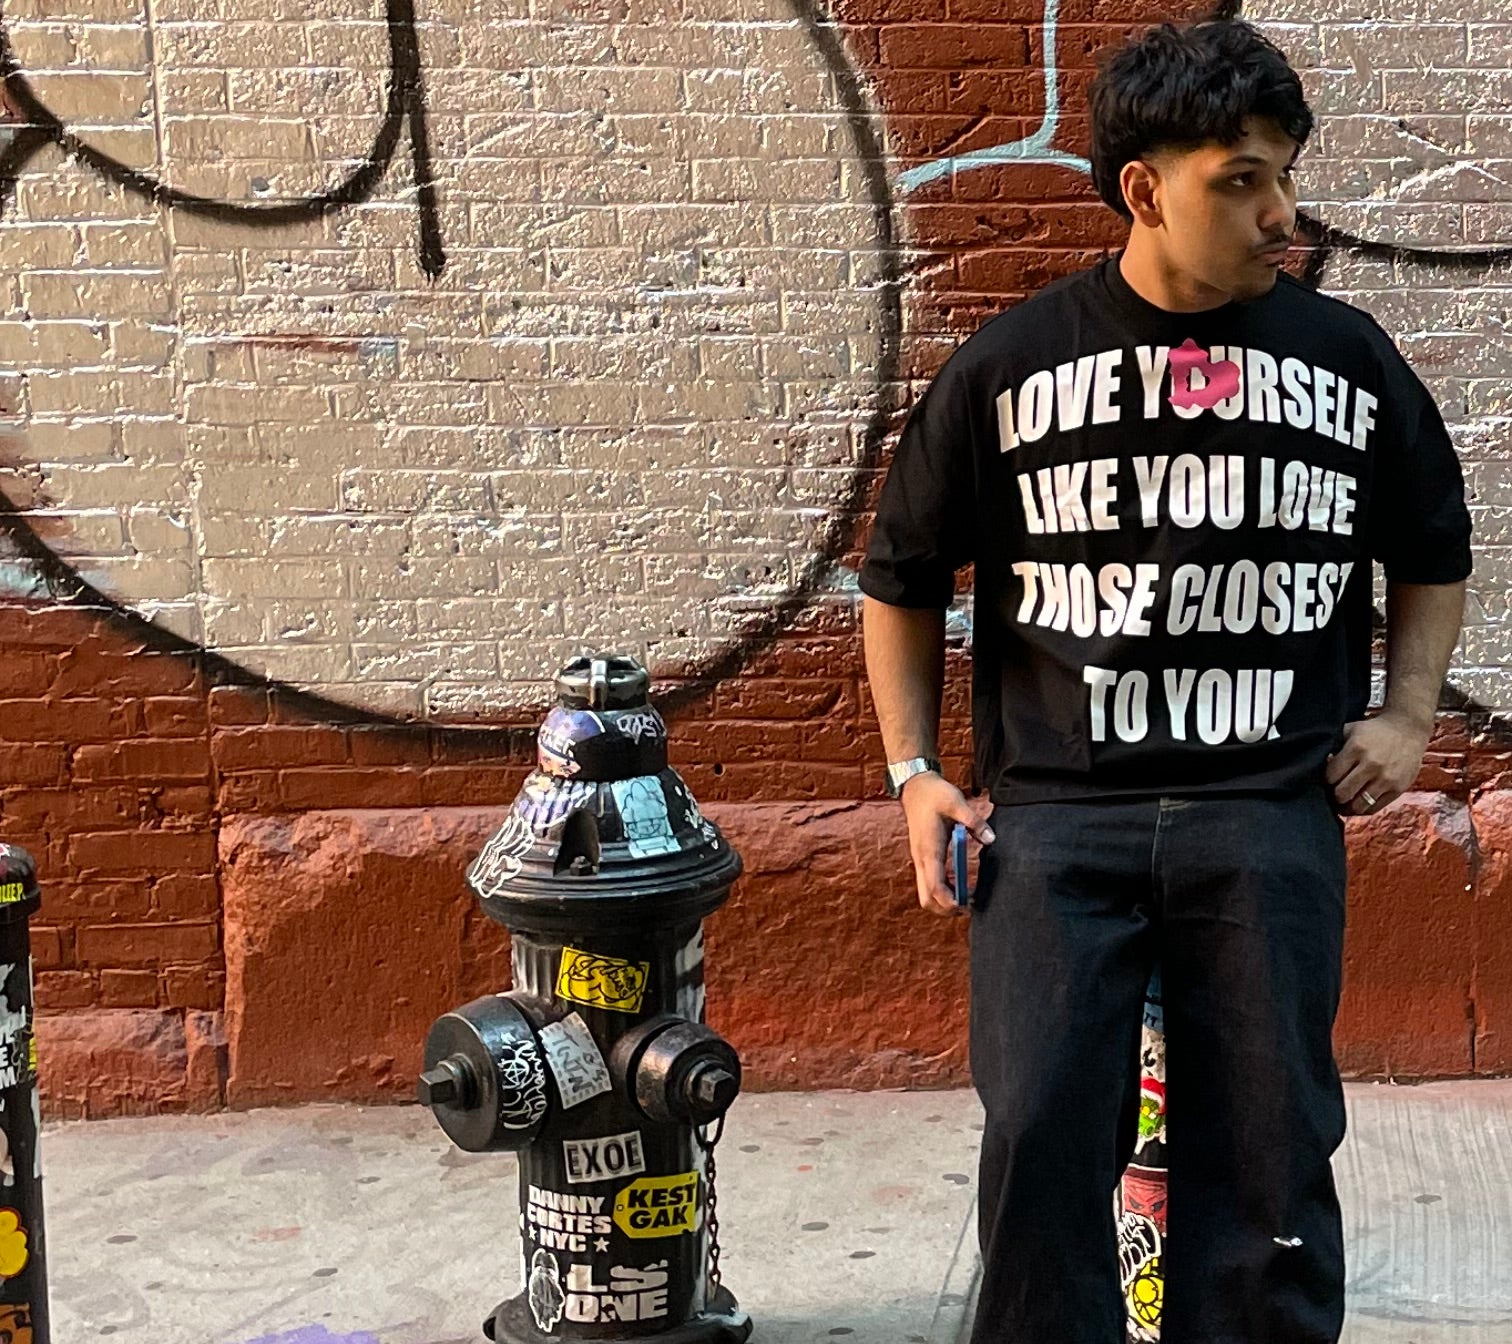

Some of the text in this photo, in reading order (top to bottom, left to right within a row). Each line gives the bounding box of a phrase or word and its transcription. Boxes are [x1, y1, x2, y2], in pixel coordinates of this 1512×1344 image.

[996, 348, 1123, 453] LOVE
[1017, 453, 1357, 536] LIKE YOU LOVE
[1012, 561, 1160, 638] THOSE
[1083, 665, 1295, 745] TO YOU!
[566, 1134, 643, 1178] EXOE
[528, 1184, 605, 1213] DANNY
[628, 1182, 695, 1209] KEST
[527, 1202, 612, 1234] CORTES
[629, 1205, 688, 1230] GAK
[540, 1226, 587, 1253] NYC
[565, 1288, 668, 1323] ONE
